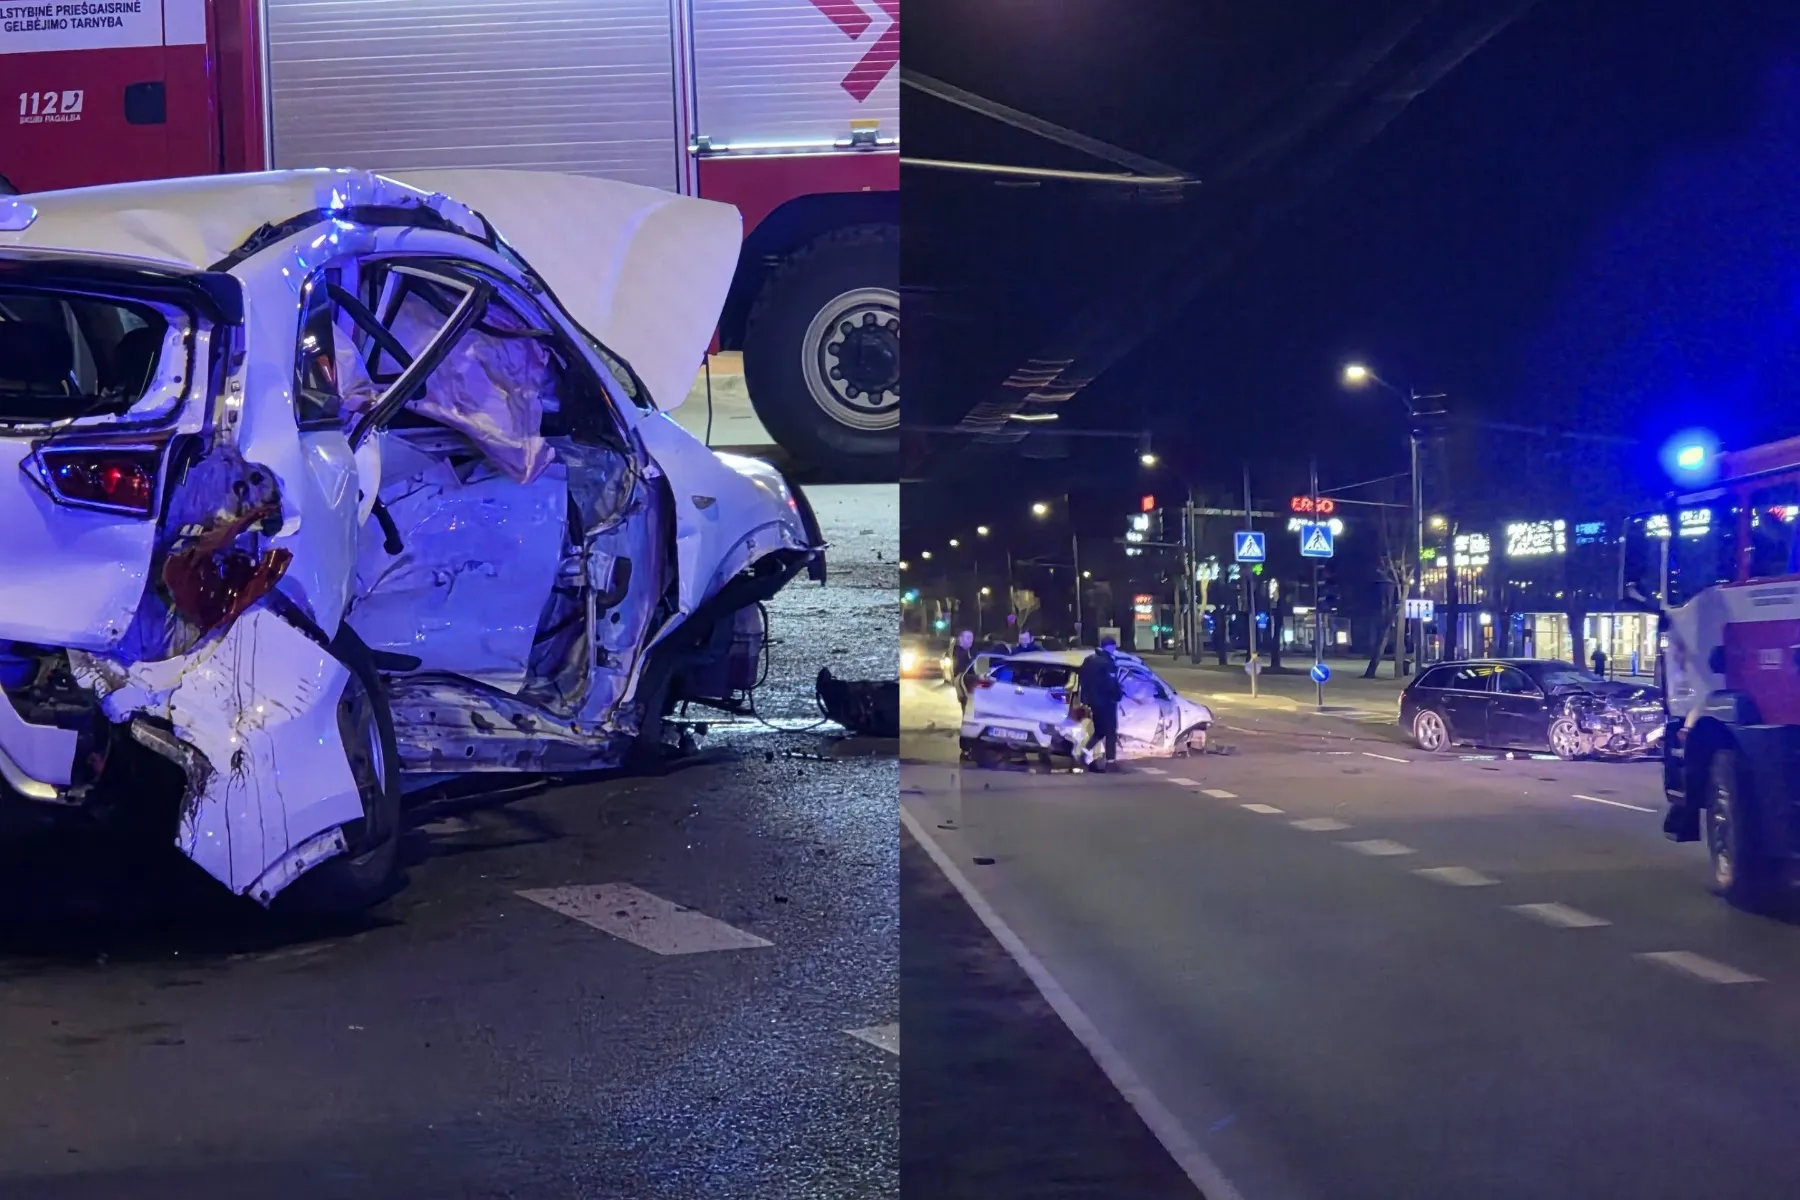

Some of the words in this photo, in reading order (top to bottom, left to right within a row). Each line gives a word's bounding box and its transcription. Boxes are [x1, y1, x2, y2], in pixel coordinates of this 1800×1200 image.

[0, 4, 53, 19] LSTYBINĖ
[56, 0, 141, 15] PRIEŠGAISRINĖ
[4, 18, 68, 32] GELBĖJIMO
[71, 16, 123, 29] TARNYBA
[19, 91, 58, 115] 112
[45, 114, 81, 123] PAGALBA
